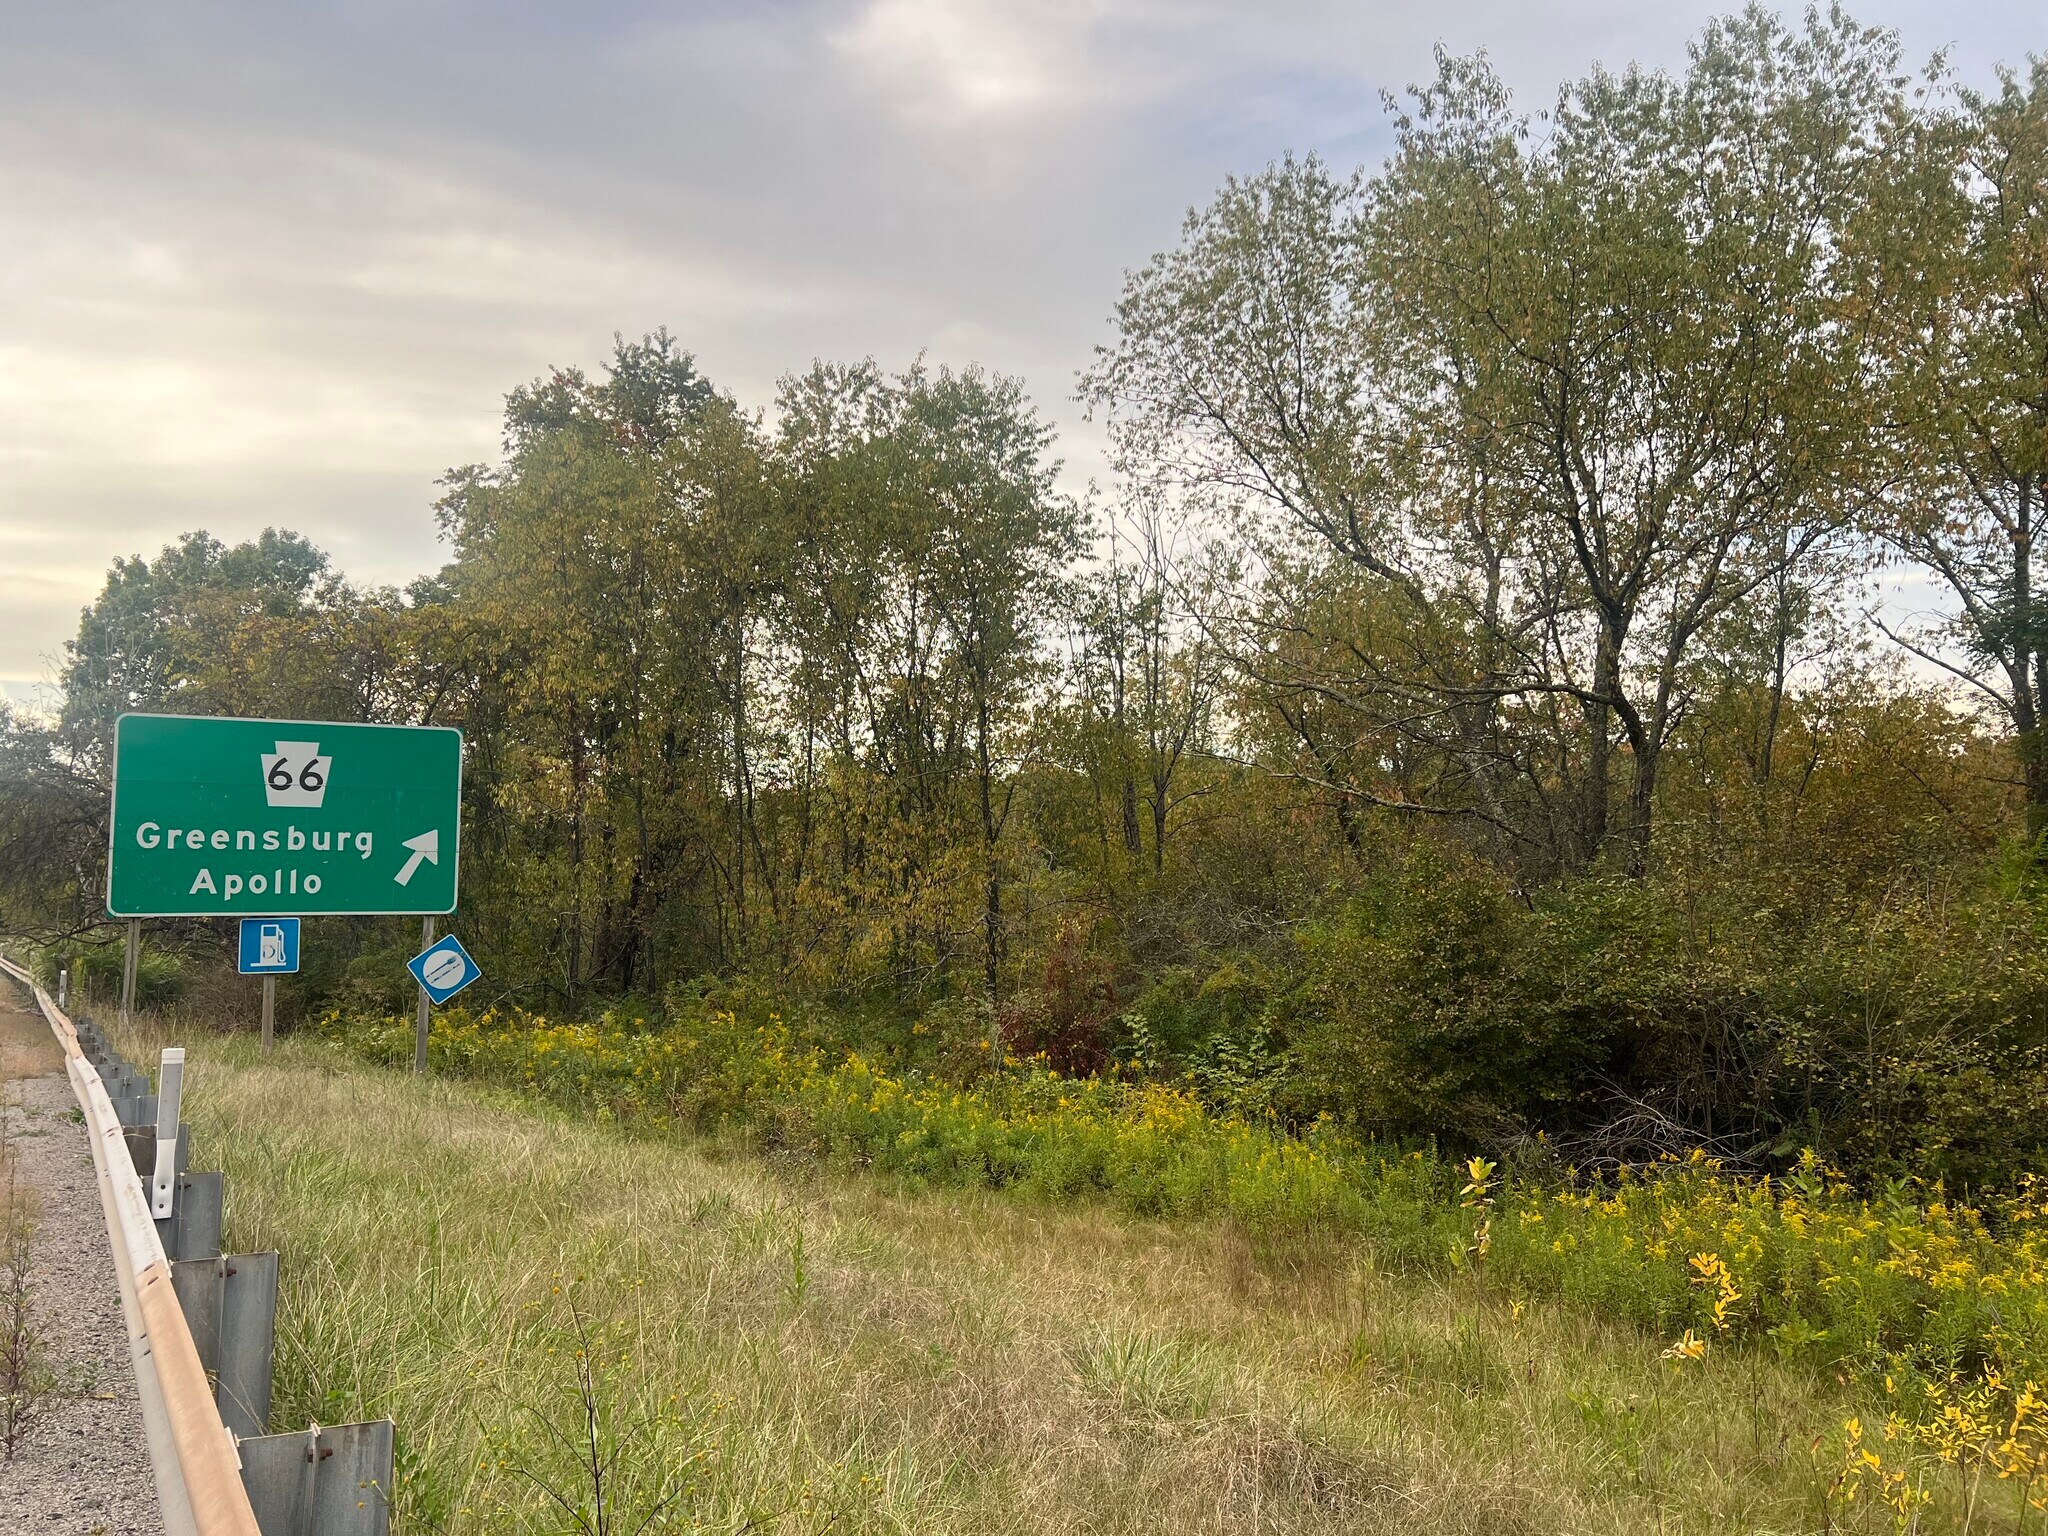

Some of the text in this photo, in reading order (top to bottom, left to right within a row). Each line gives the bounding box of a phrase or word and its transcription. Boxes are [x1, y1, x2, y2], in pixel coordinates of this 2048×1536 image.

[268, 757, 324, 791] 66
[136, 822, 373, 860] Greensburg
[189, 868, 322, 900] Apollo
